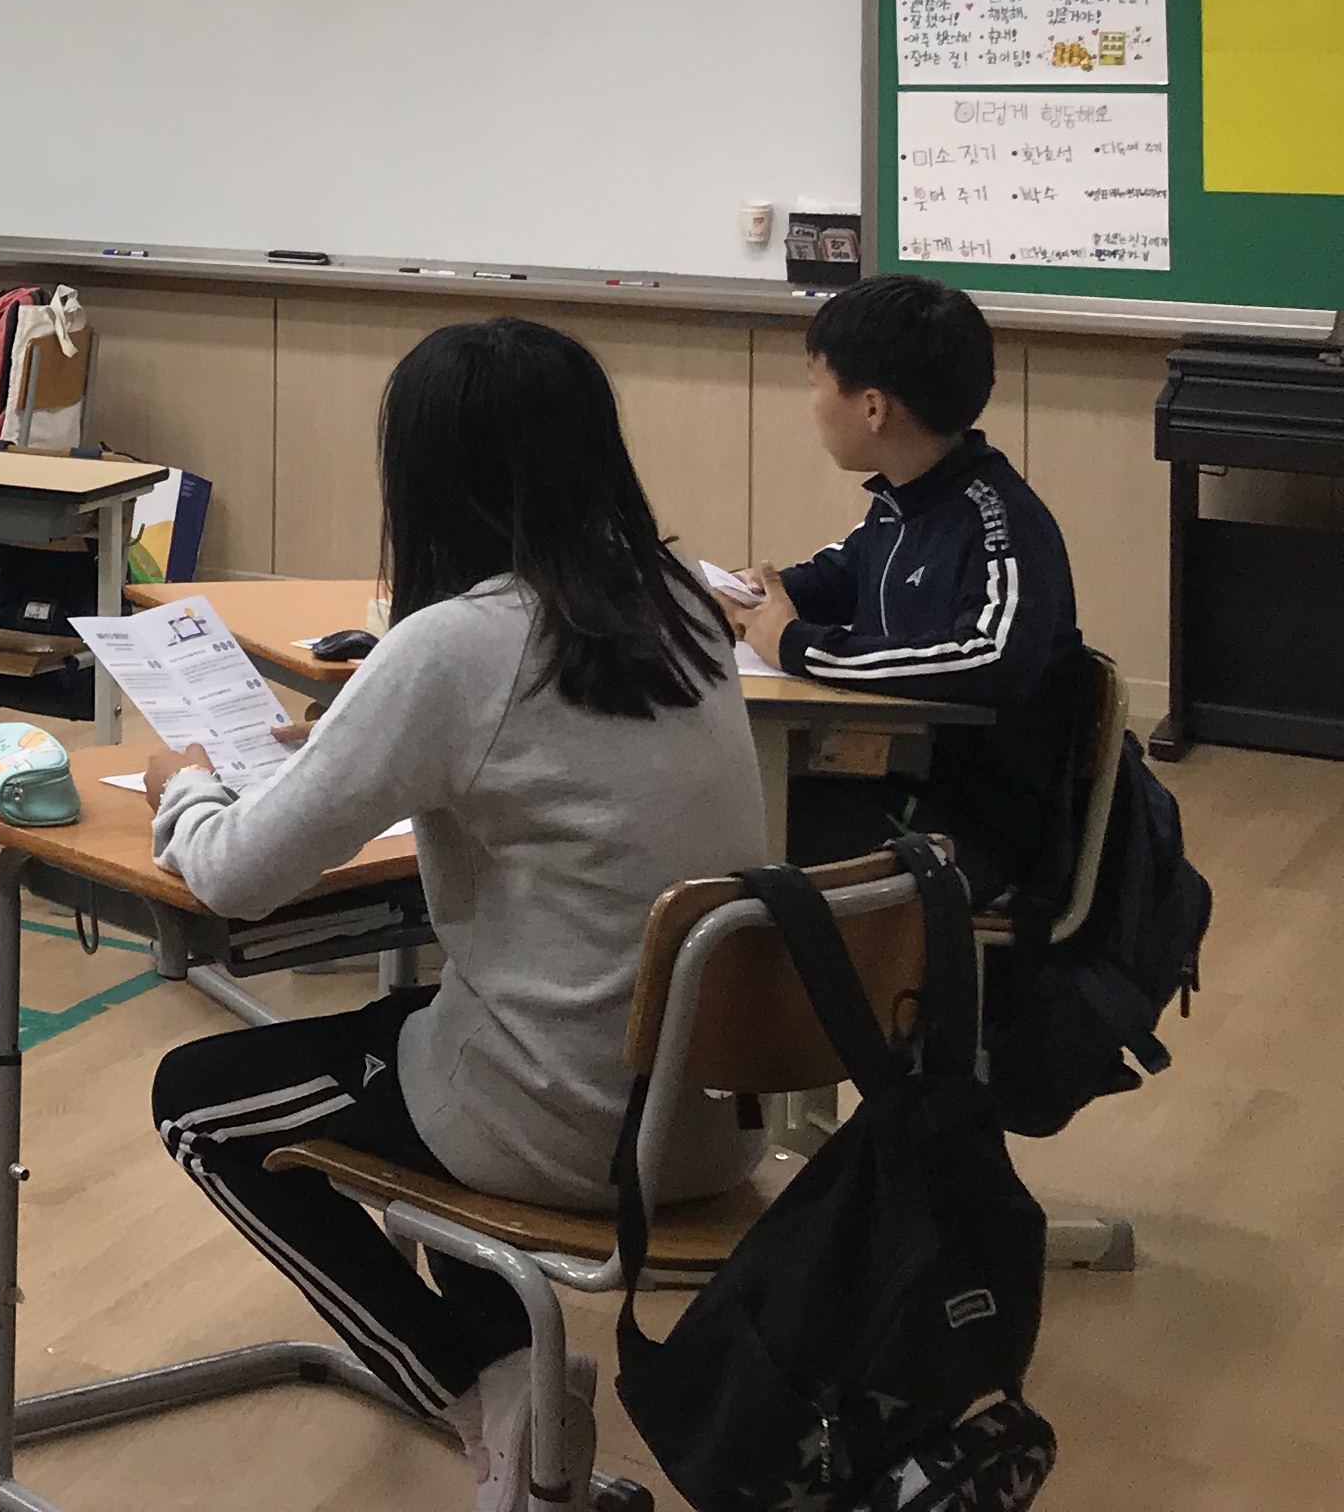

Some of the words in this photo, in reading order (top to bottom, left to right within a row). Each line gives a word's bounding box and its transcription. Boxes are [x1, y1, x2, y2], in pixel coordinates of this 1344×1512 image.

[1040, 102, 1113, 129] 행동해요
[912, 146, 956, 168] 미소
[958, 143, 997, 165] 짓기
[1021, 142, 1073, 165] 환호성
[957, 184, 988, 205] 주기
[1019, 185, 1059, 204] 박수
[910, 236, 954, 260] 함께
[958, 238, 992, 259] 하기
